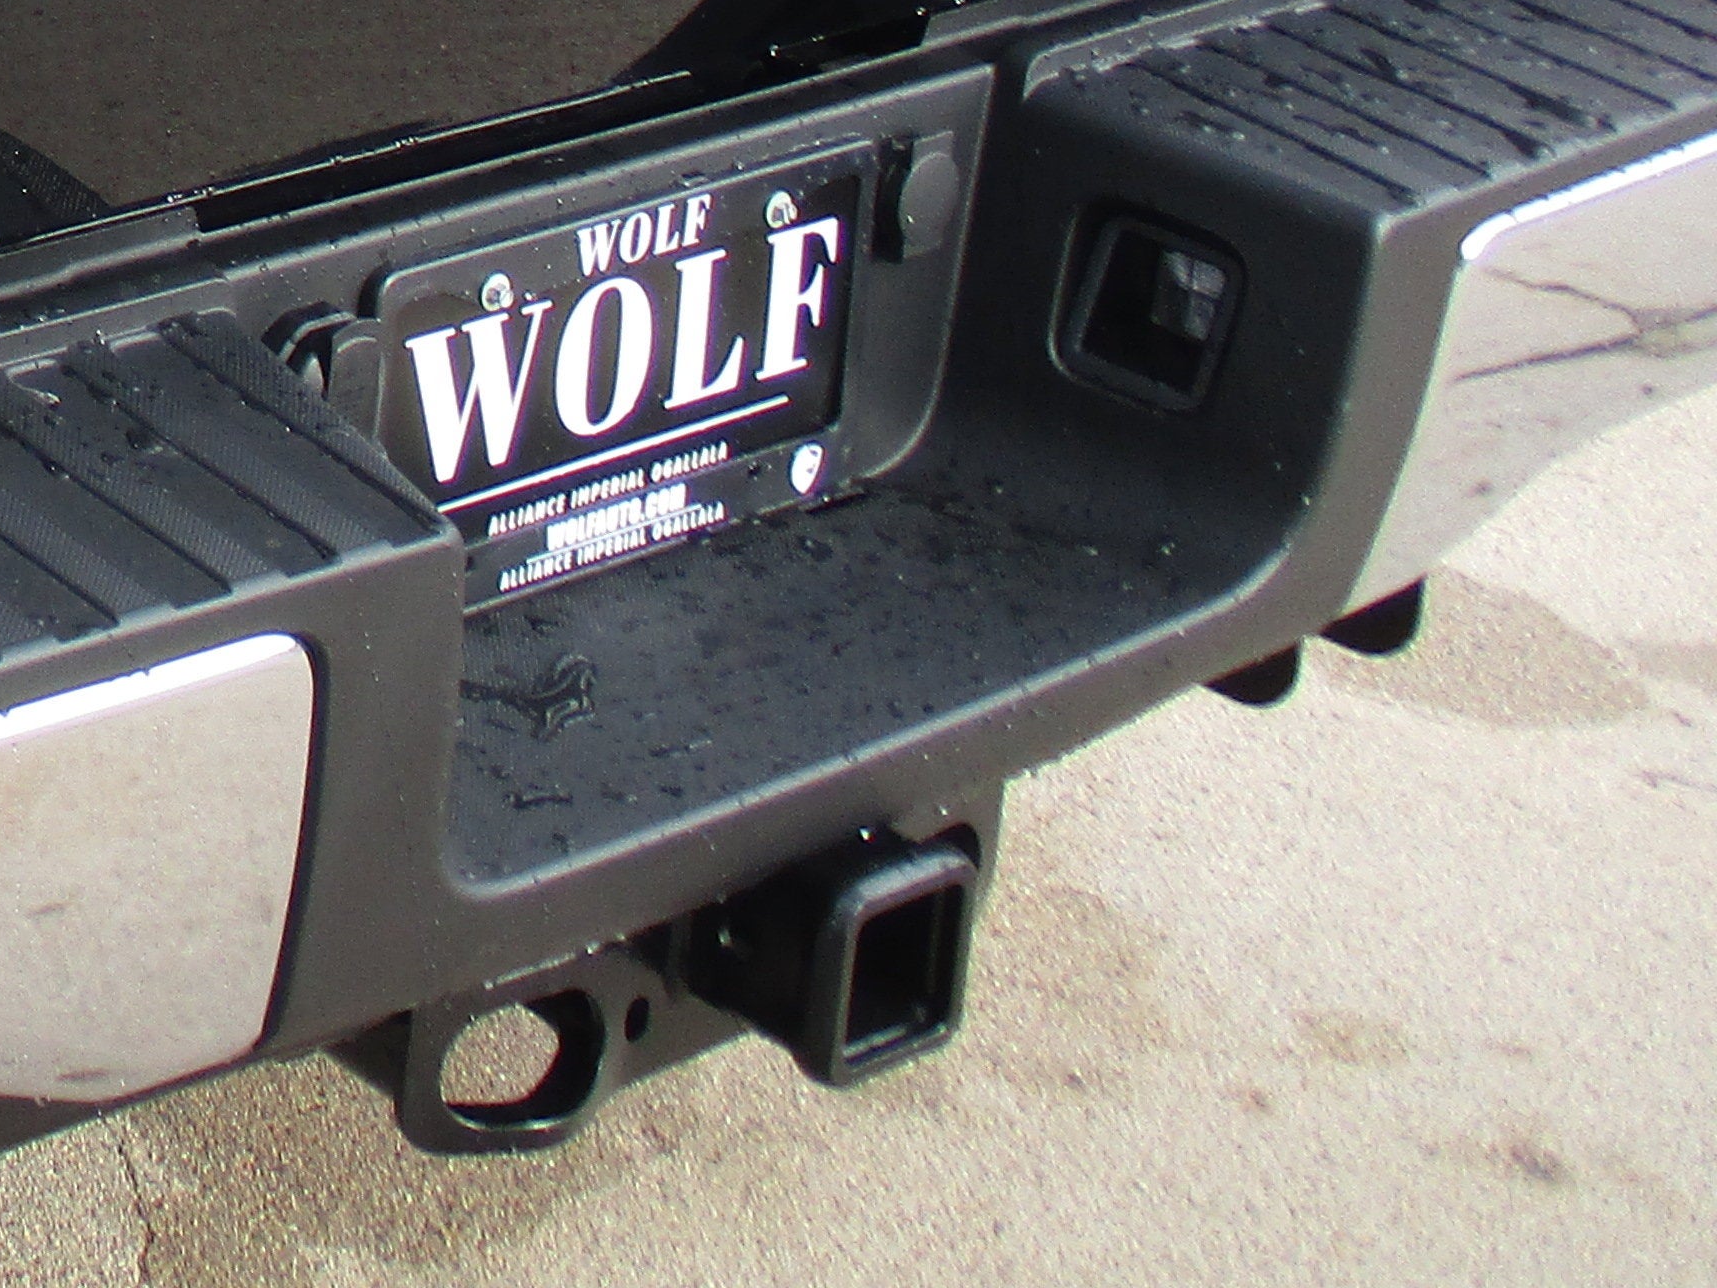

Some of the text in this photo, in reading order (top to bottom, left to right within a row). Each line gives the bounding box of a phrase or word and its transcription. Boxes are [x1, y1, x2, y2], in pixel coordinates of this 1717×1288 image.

[575, 192, 712, 277] WOLF
[403, 216, 840, 484] WOLF
[488, 492, 566, 538] ALLIANCE
[570, 468, 646, 510] IMPERIAL
[545, 482, 688, 552] WOLFAUTO.COM
[499, 552, 573, 593] ALLIANCE
[576, 526, 648, 566] IMPERIAL
